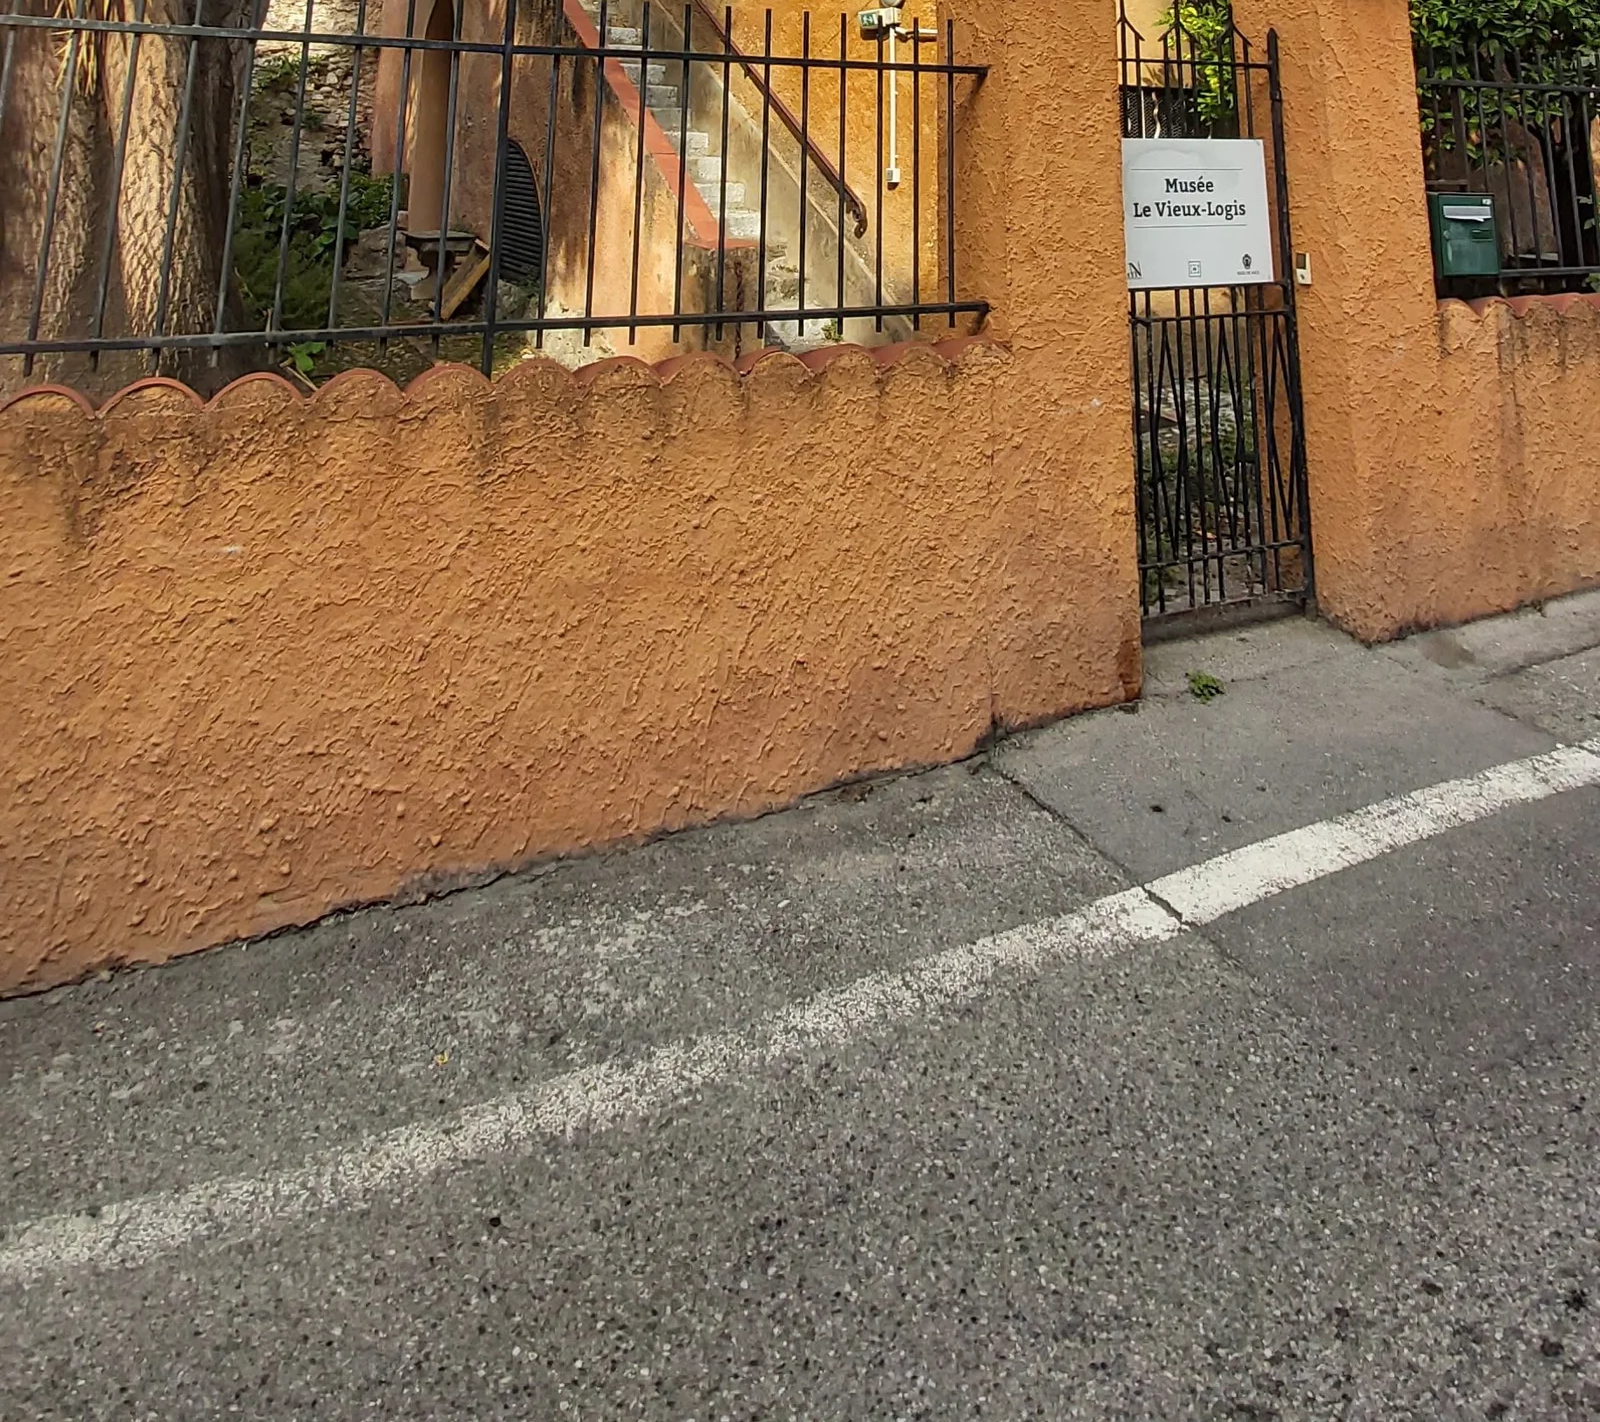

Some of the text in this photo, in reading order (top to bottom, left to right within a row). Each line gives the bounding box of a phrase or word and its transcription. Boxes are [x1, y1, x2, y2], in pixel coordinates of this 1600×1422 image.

[1165, 175, 1214, 193] Musée
[1133, 199, 1247, 220] Le Vieux-Logis
